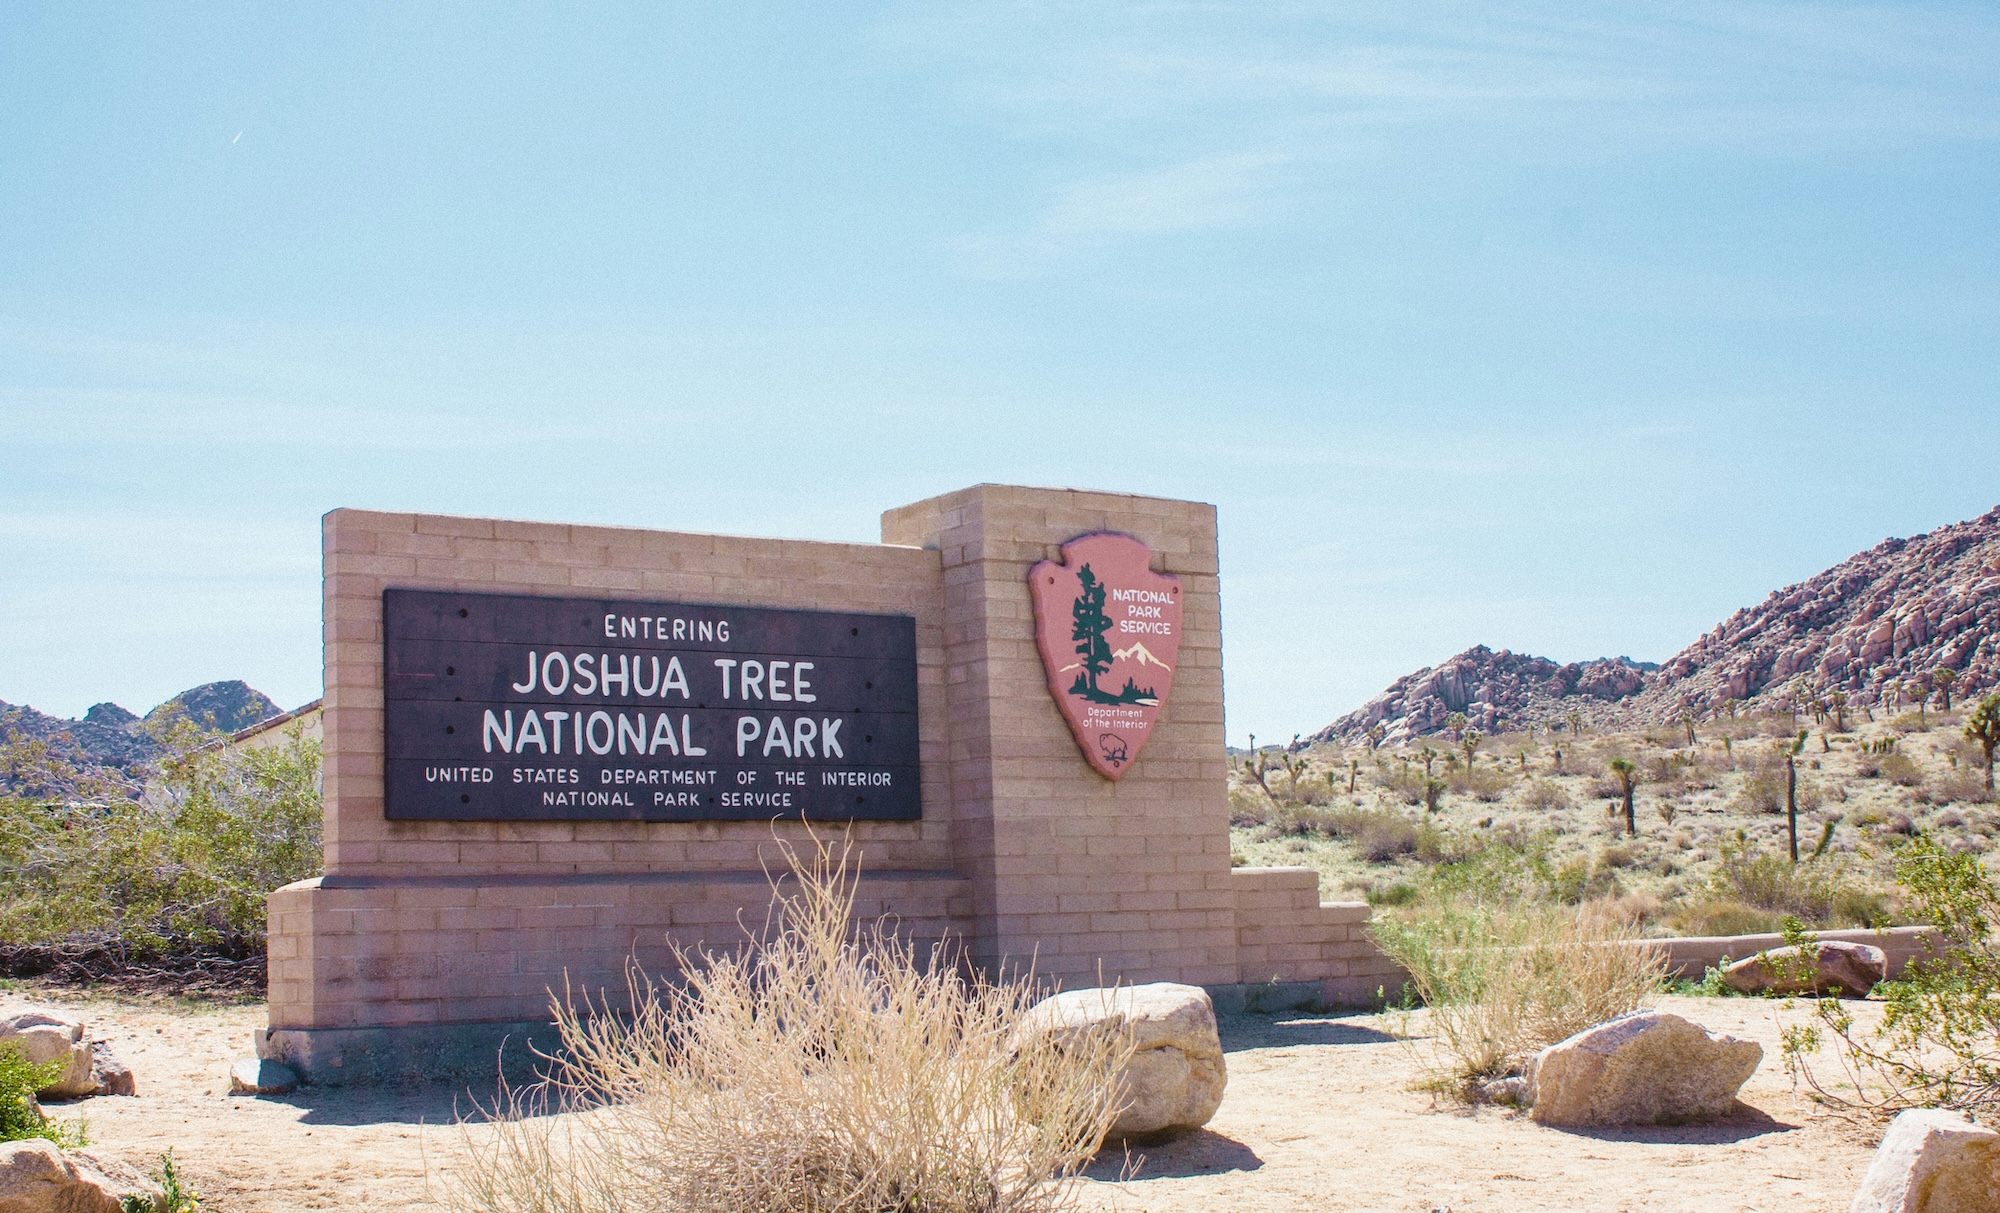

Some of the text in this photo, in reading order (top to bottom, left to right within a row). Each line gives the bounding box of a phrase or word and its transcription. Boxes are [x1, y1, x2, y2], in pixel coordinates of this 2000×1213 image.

[1113, 589, 1174, 604] NATIONAL
[1129, 605, 1161, 618] PARK
[605, 614, 729, 642] ENTERING
[1120, 620, 1171, 634] SERVICE
[513, 651, 816, 702] JOSHUA TREE
[1088, 707, 1142, 718] Department
[1082, 718, 1148, 729] of the Interior
[484, 709, 843, 758] NATIONAL PARK
[425, 767, 892, 786] UNITED STATES DEPARTMENT OF THE INTERIOR
[543, 791, 792, 807] NATIONAL PARK SERVICE
